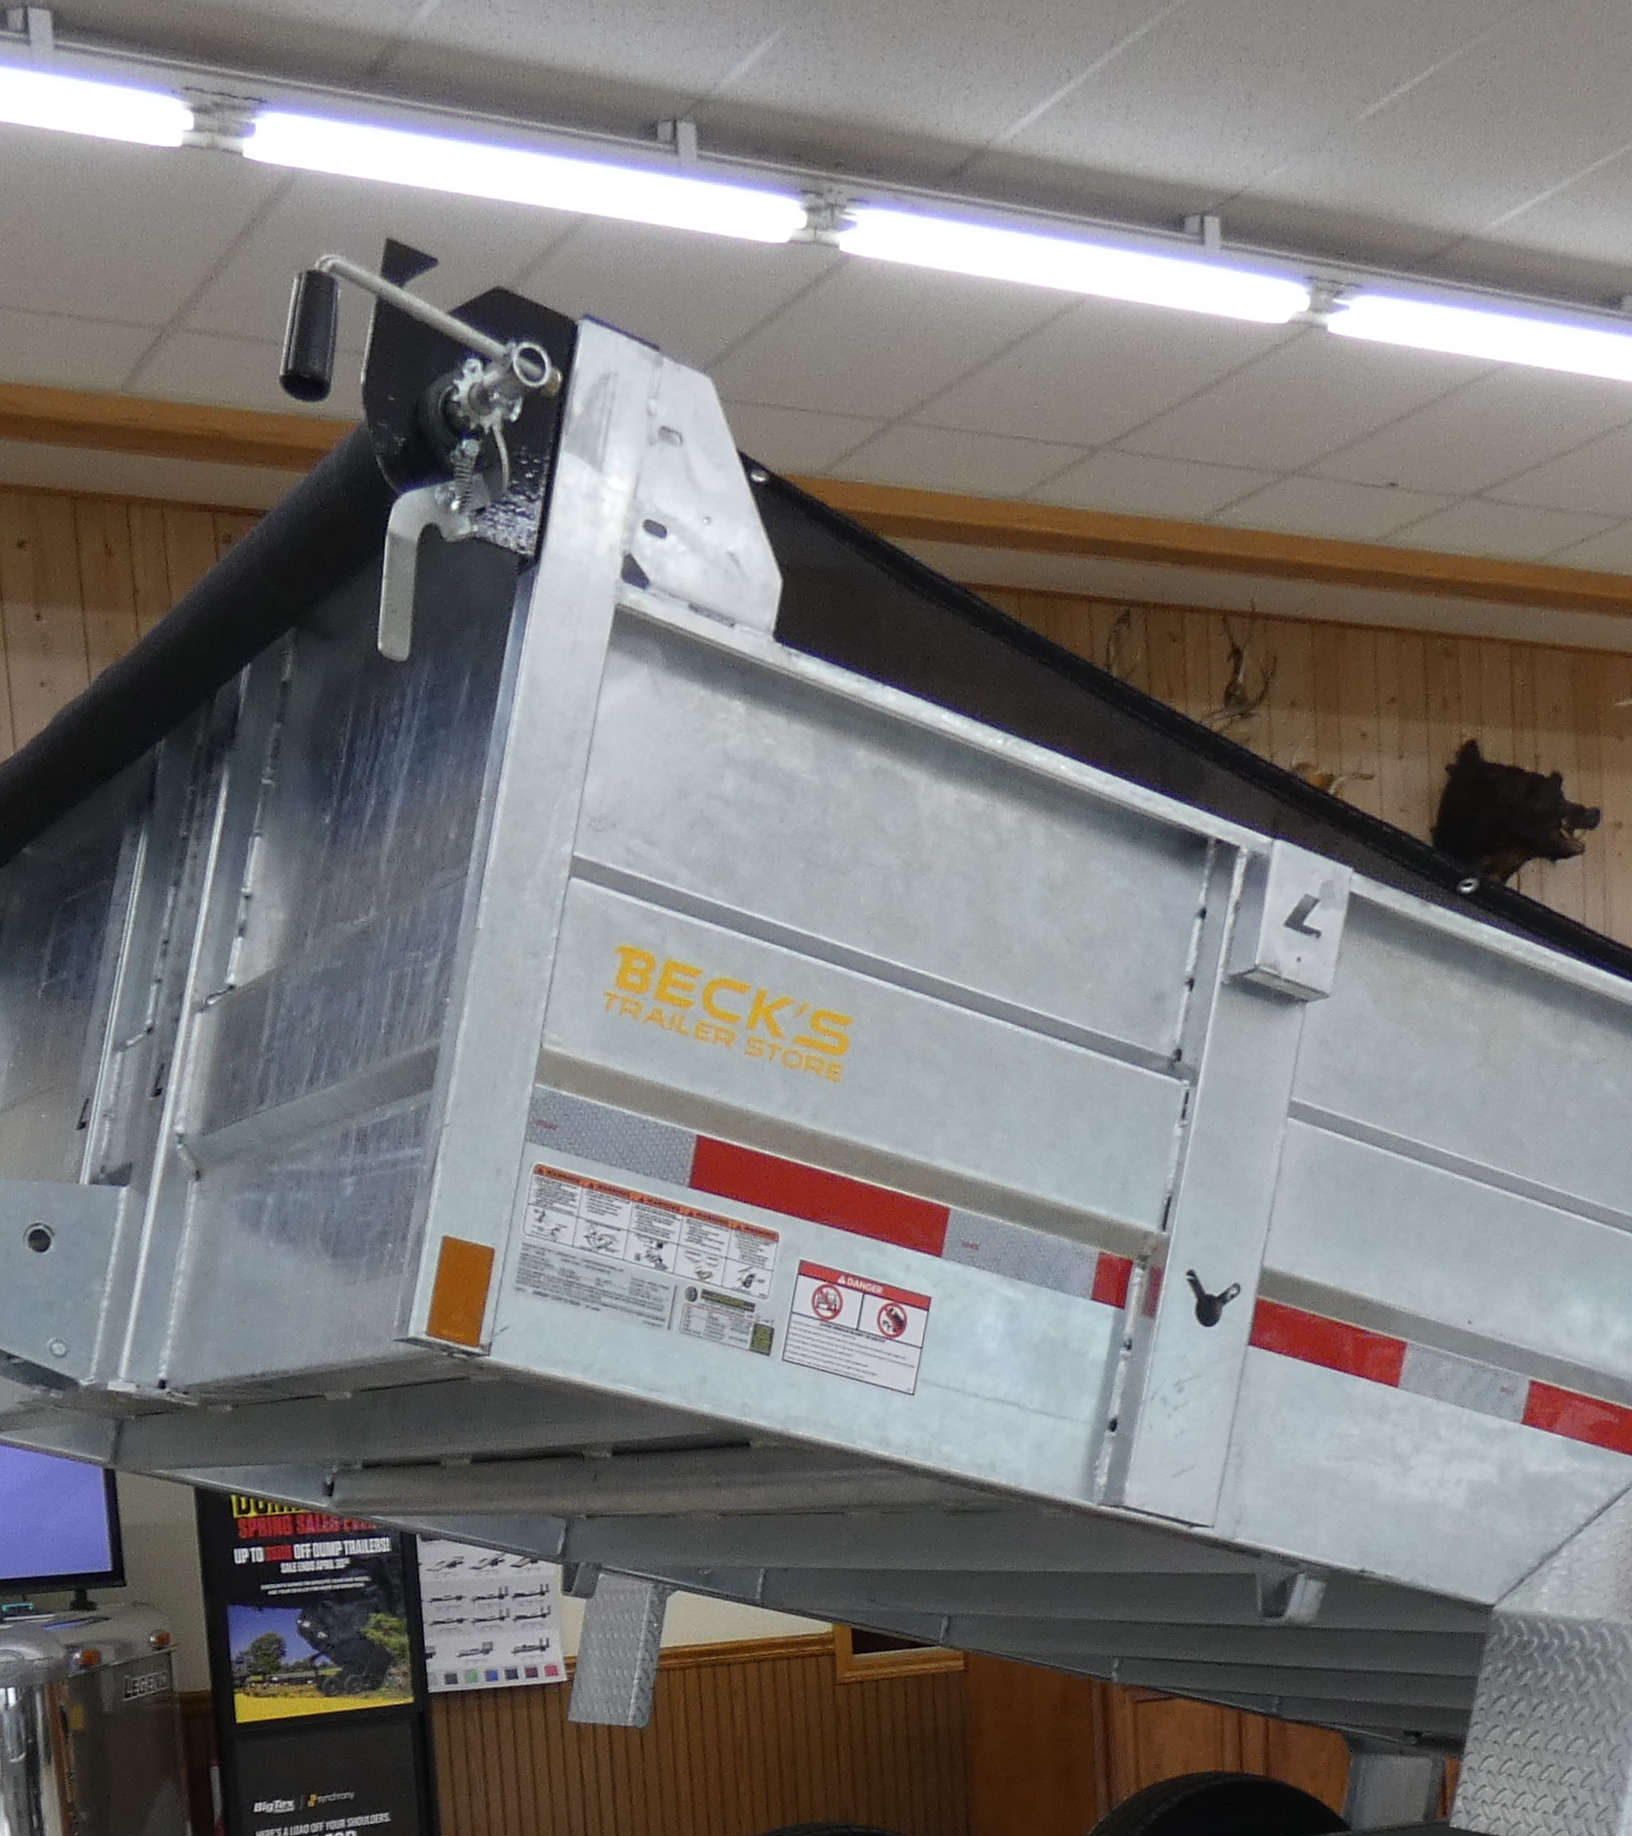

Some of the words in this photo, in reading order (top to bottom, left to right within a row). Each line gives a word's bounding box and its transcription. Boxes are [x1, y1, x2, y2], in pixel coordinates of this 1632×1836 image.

[614, 944, 855, 1057] BECK'S
[603, 992, 737, 1051] TRAILER
[744, 1035, 844, 1083] STORE
[846, 1277, 884, 1295] DANGER
[237, 1514, 294, 1539] SPRING
[233, 1548, 249, 1565] UP
[250, 1546, 265, 1563] TO
[293, 1542, 311, 1559] OFF
[312, 1540, 343, 1559] DUMP
[343, 1536, 392, 1556] TRAILERS!
[289, 1823, 309, 1836] LOAD
[310, 1821, 324, 1833] OFF
[325, 1818, 345, 1831] YOUR
